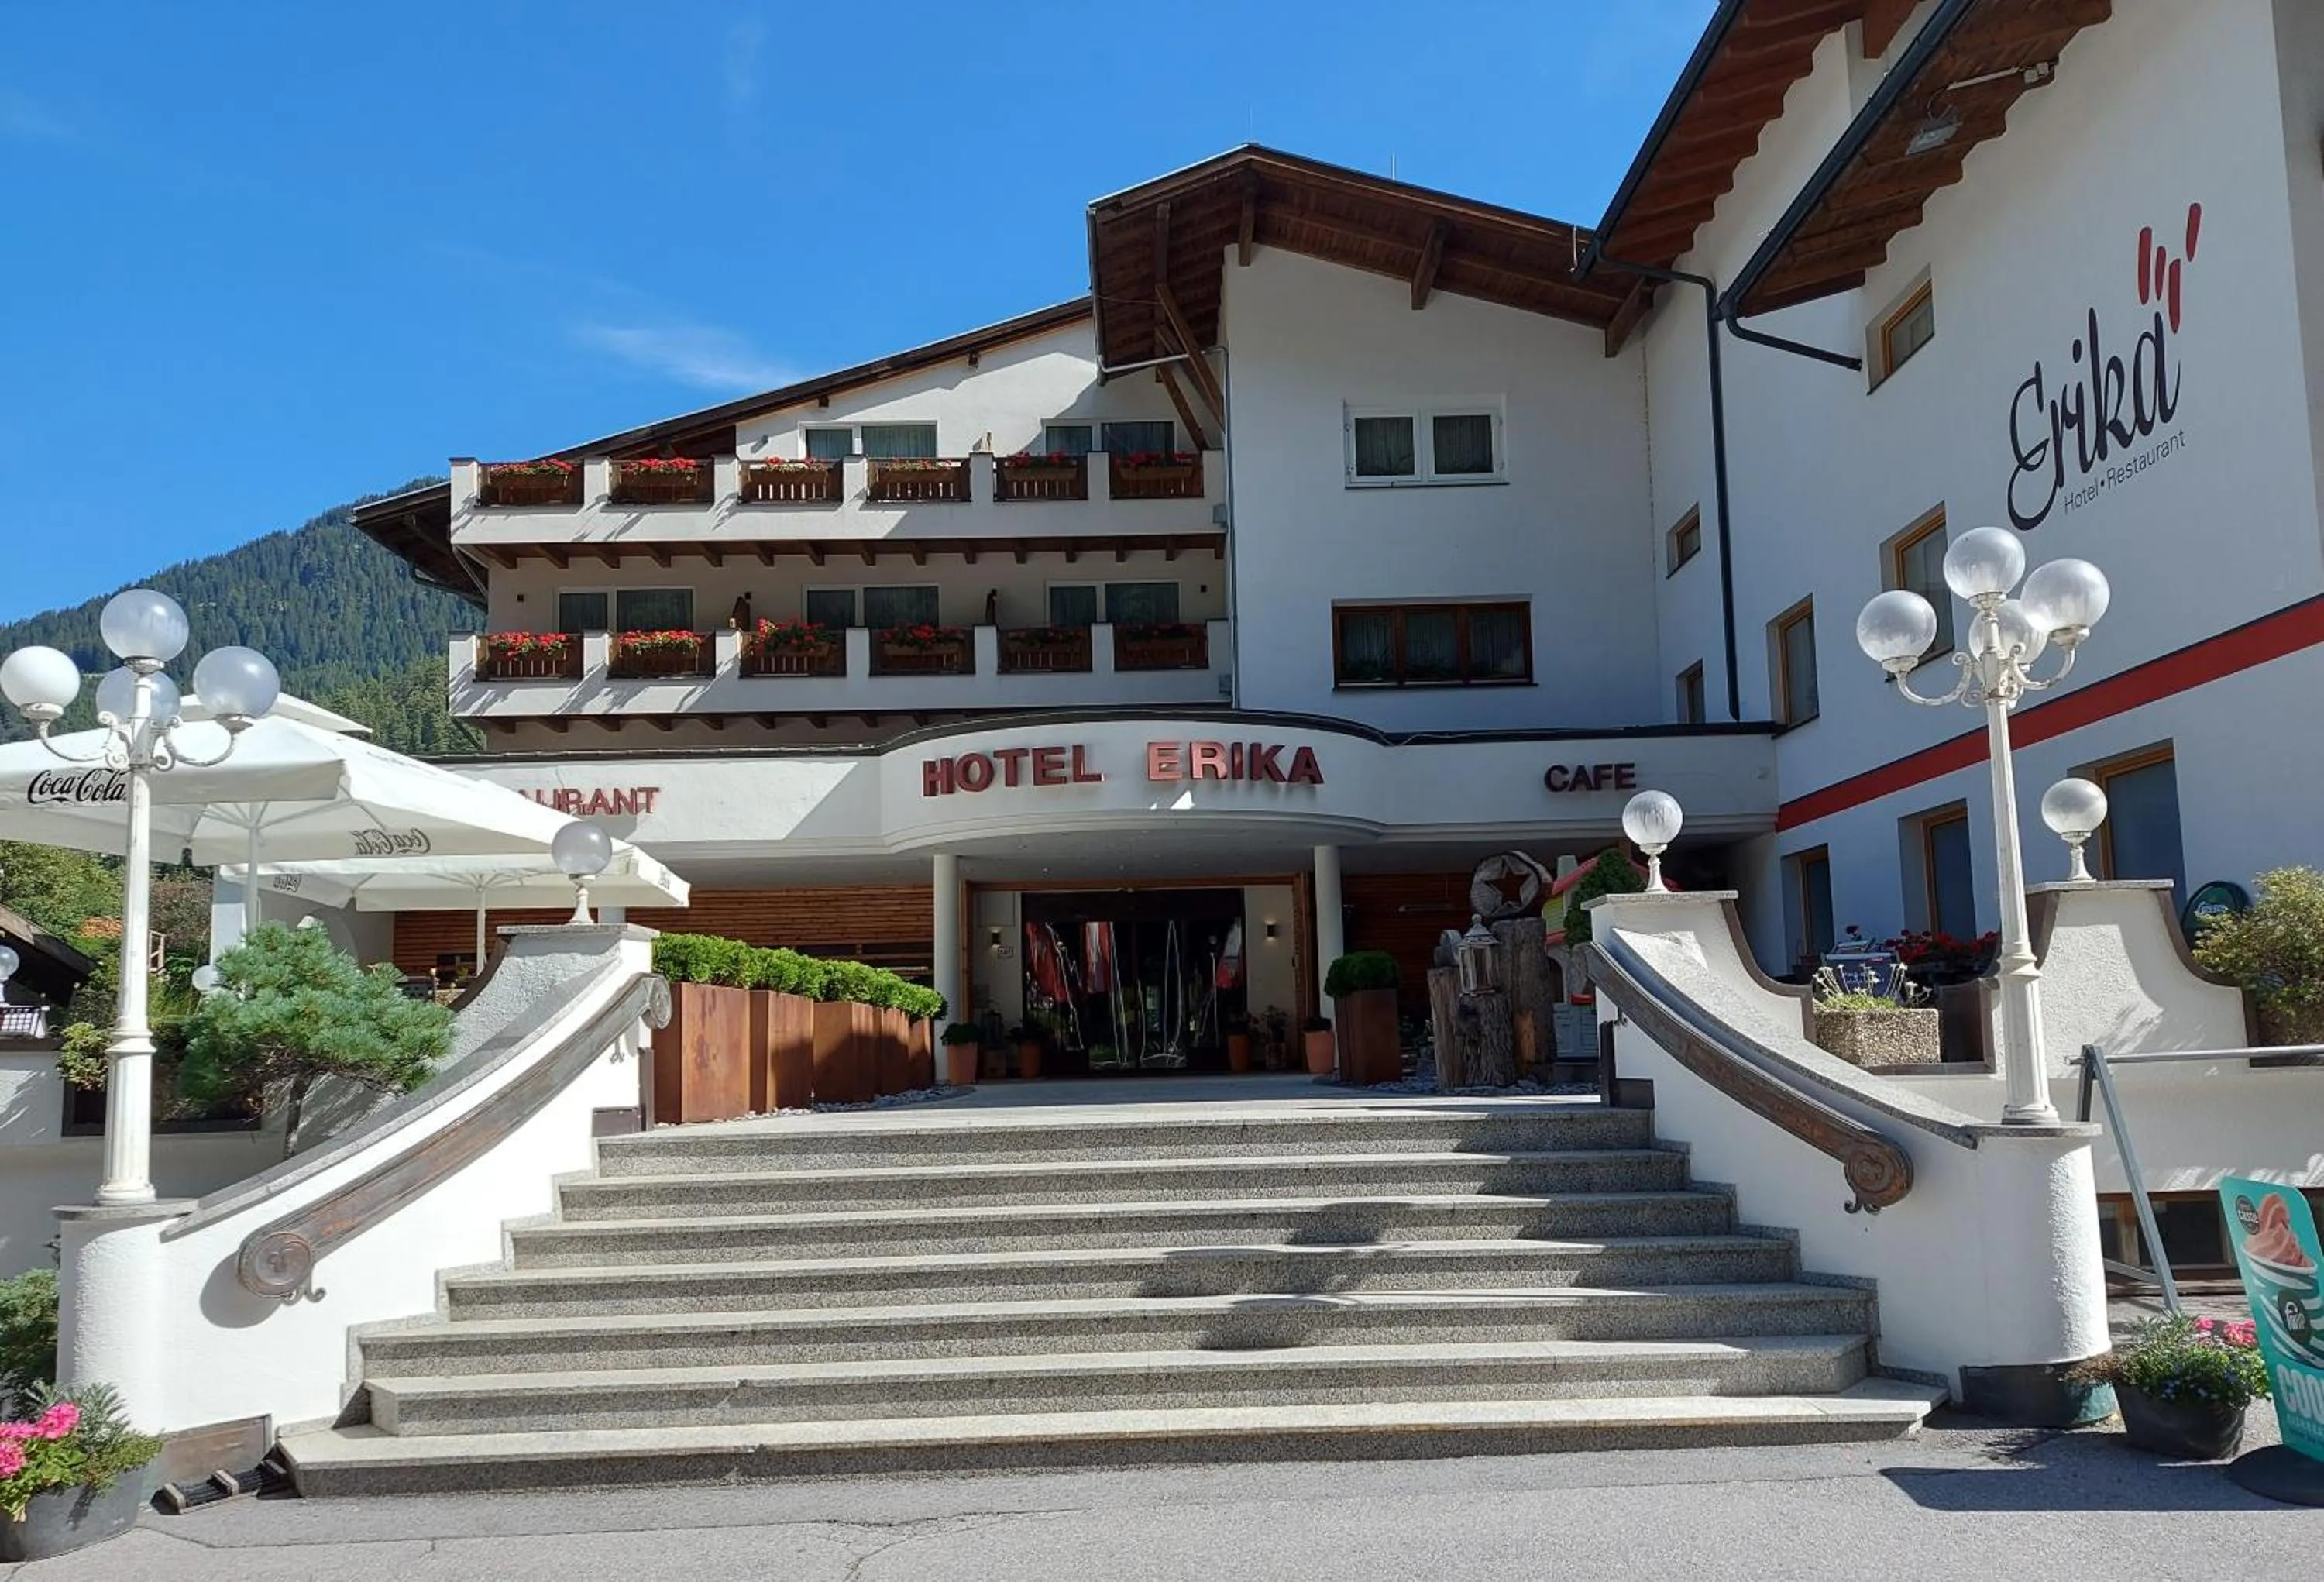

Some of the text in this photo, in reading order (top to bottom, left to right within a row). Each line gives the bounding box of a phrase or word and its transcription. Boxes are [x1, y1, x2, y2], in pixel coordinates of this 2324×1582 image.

[2007, 308, 2181, 531] Erika
[2064, 428, 2185, 514] Hotel Restaurant
[27, 768, 132, 804] Coca-Cola
[923, 741, 1324, 797] HOTEL ERIKA
[1544, 762, 1636, 792] CAFE
[518, 786, 660, 816] URANT
